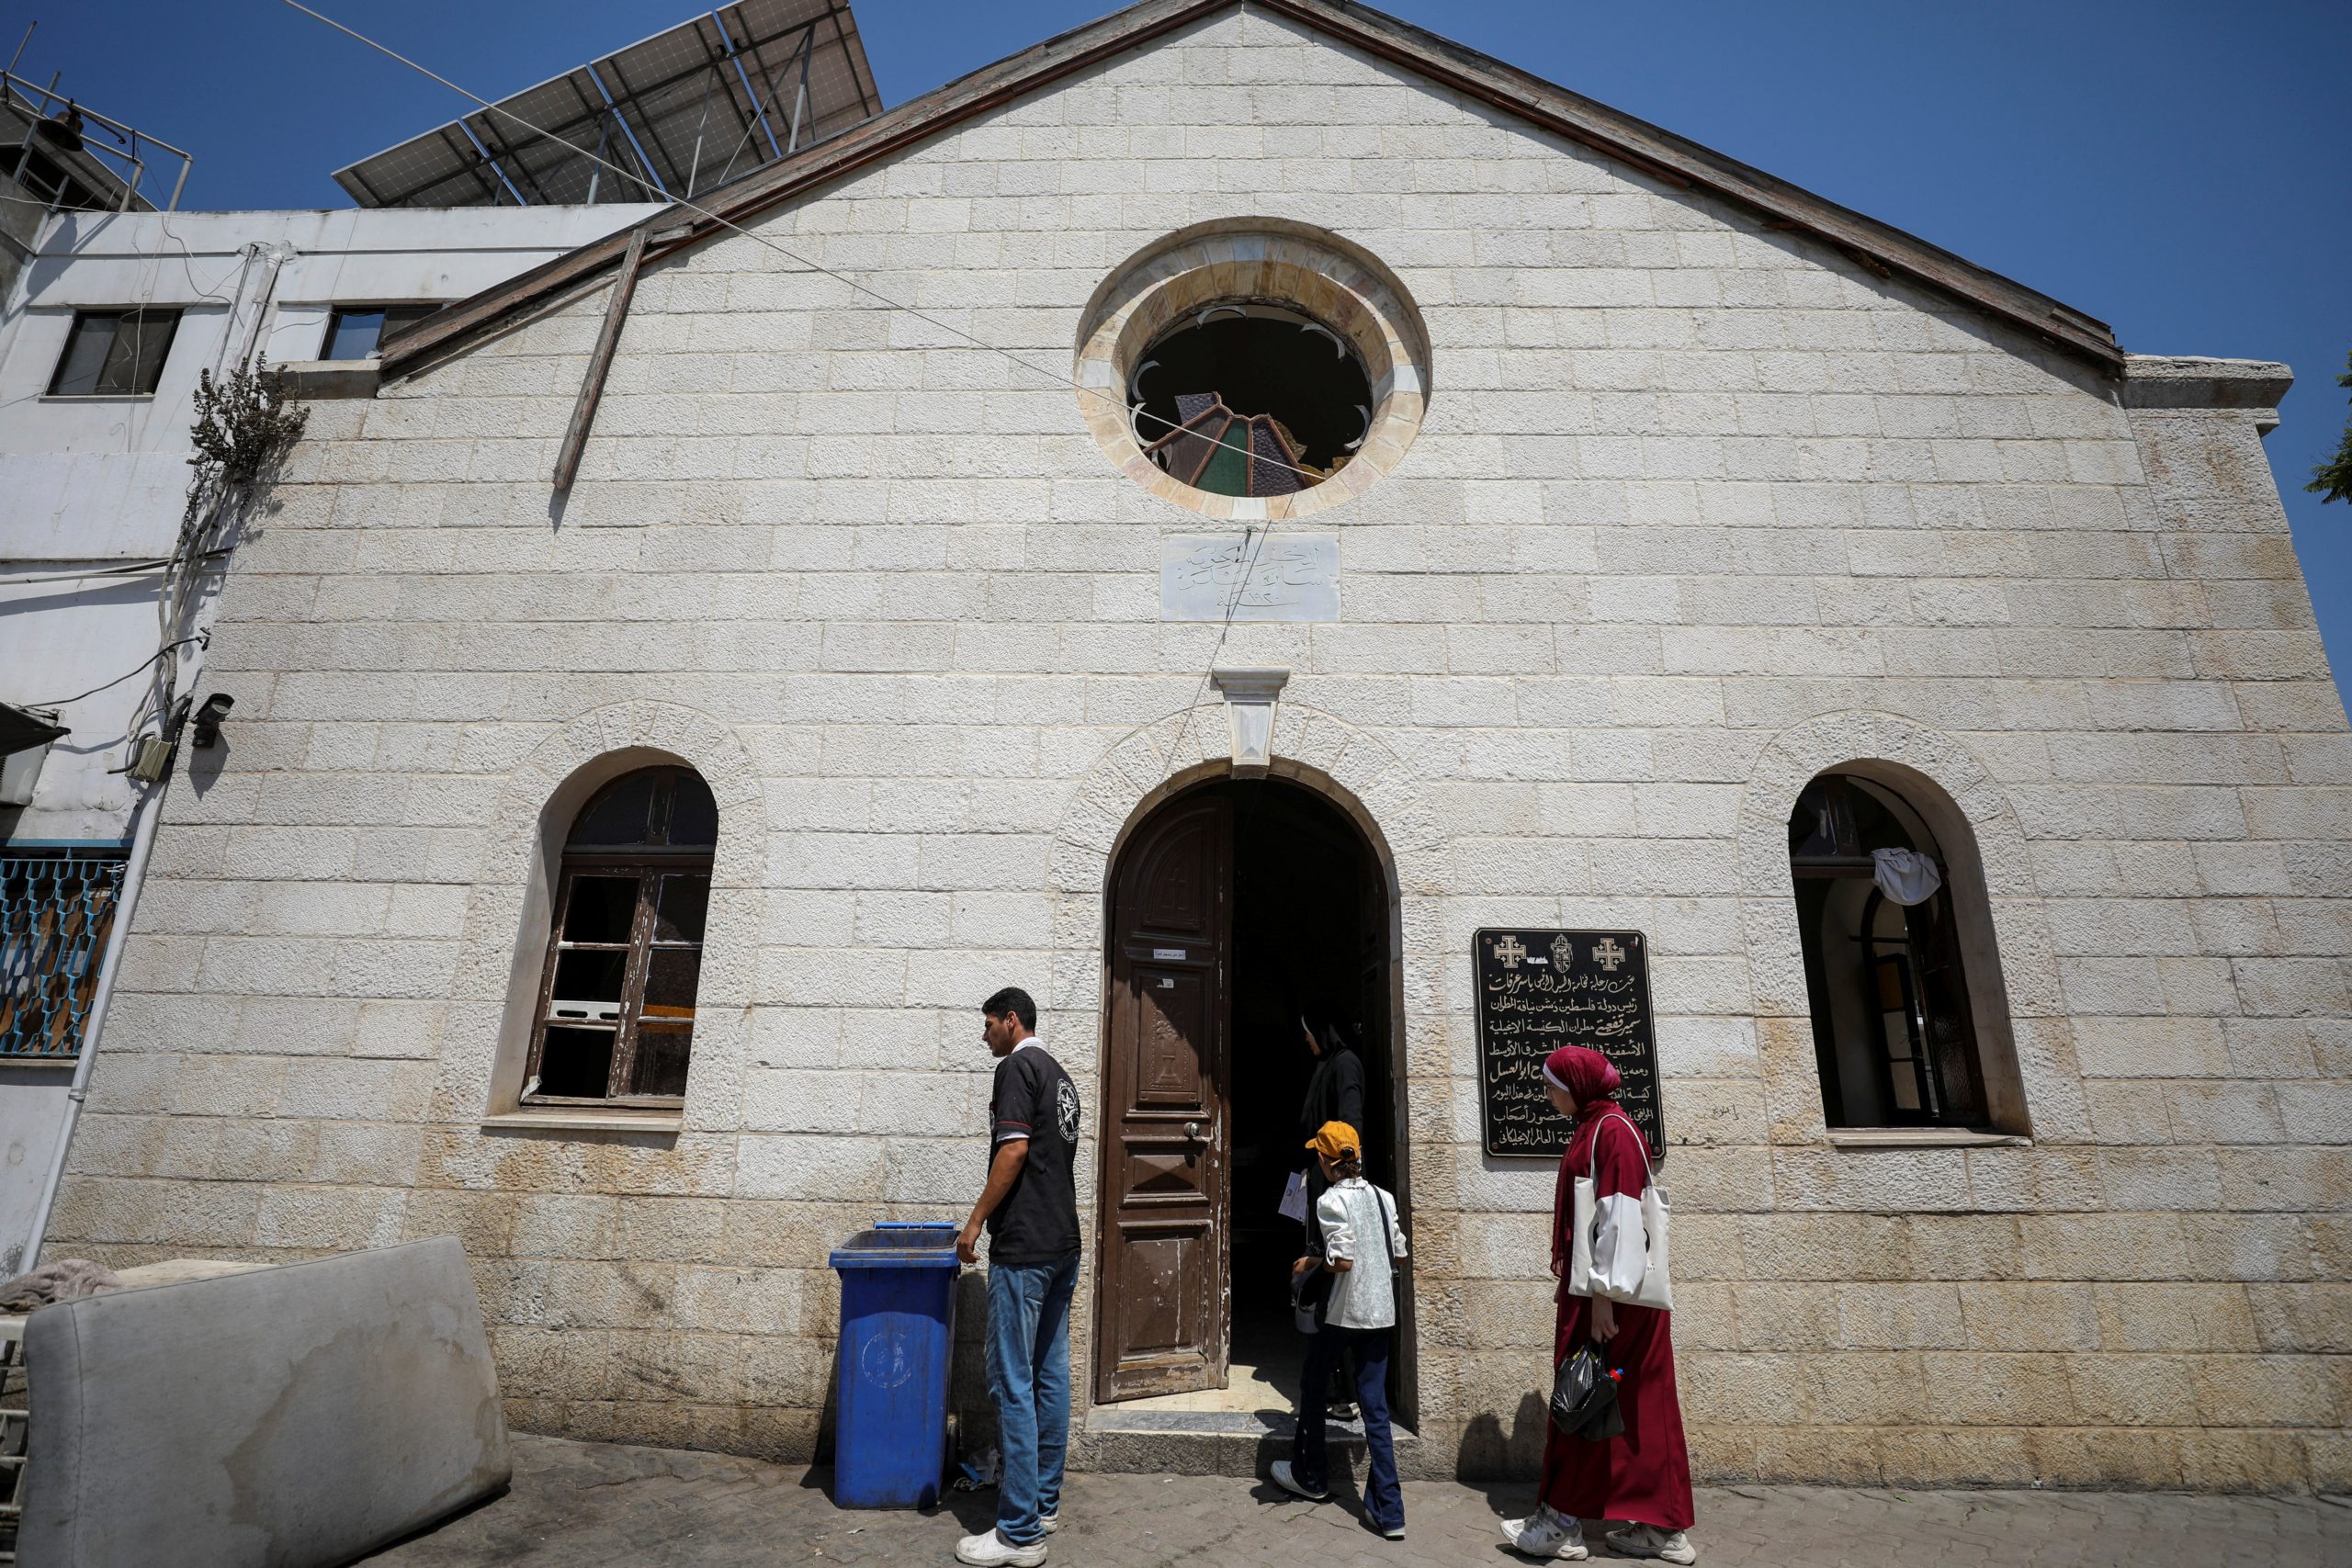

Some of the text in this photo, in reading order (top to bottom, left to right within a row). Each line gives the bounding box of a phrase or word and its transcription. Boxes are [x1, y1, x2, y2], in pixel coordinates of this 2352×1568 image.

[1488, 968, 1635, 994] تحت رعاية فخامة السيد الرئيس ياسر عرفات
[1490, 995, 1516, 1012] المطران
[1516, 998, 1535, 1014] نيافة
[1559, 997, 1596, 1014] فلسطين
[1597, 997, 1617, 1013] دولة
[1617, 998, 1637, 1013] رئيس
[1526, 1019, 1568, 1035] الكنيسة
[1568, 1018, 1595, 1034] مطران
[1617, 1019, 1641, 1036] سمير
[1489, 1039, 1521, 1057] الأوسط
[1606, 1039, 1645, 1058] الأسقفية
[1489, 1059, 1522, 1083] العسل
[1629, 1067, 1649, 1077] ومعه
[1491, 1084, 1511, 1100] اليوم
[1511, 1083, 1524, 1100] هذا
[1626, 1085, 1652, 1101] كنيسة
[1493, 1104, 1529, 1124] أصحاب
[1526, 1109, 1573, 1124] بحضور
[1634, 1107, 1654, 1124] الموافق
[1530, 1128, 1555, 1145] العالم
